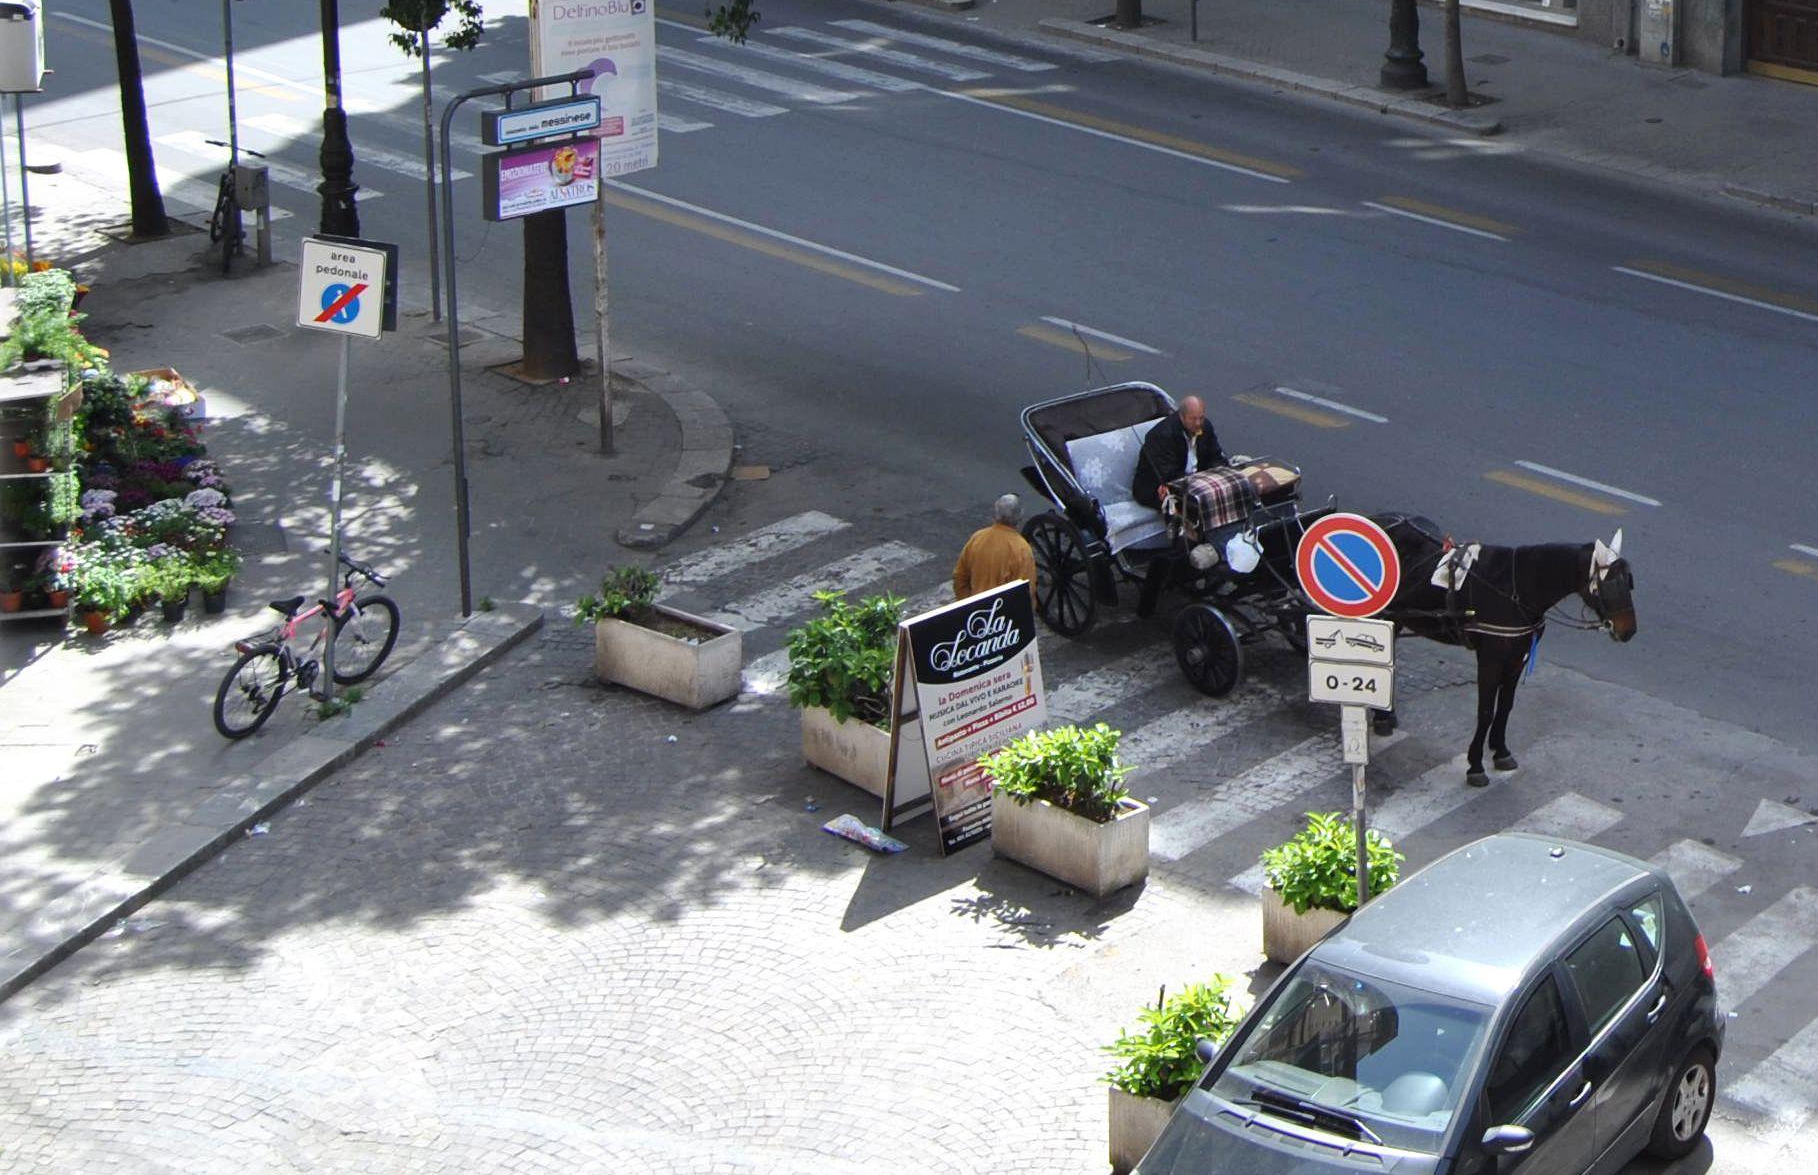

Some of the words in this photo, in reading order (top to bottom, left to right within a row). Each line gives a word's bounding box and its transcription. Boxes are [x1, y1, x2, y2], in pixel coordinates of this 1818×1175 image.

[316, 264, 368, 281] pedonale
[331, 252, 356, 264] area
[967, 597, 1005, 639] La
[930, 619, 1020, 672] Locanda
[929, 706, 954, 722] MUSICA
[956, 700, 968, 711] DAL
[969, 693, 985, 706] VIVO
[993, 677, 1024, 696] KARAOKE
[948, 679, 991, 703] Domenica
[993, 671, 1011, 684] sera
[936, 747, 962, 764] CUCINA
